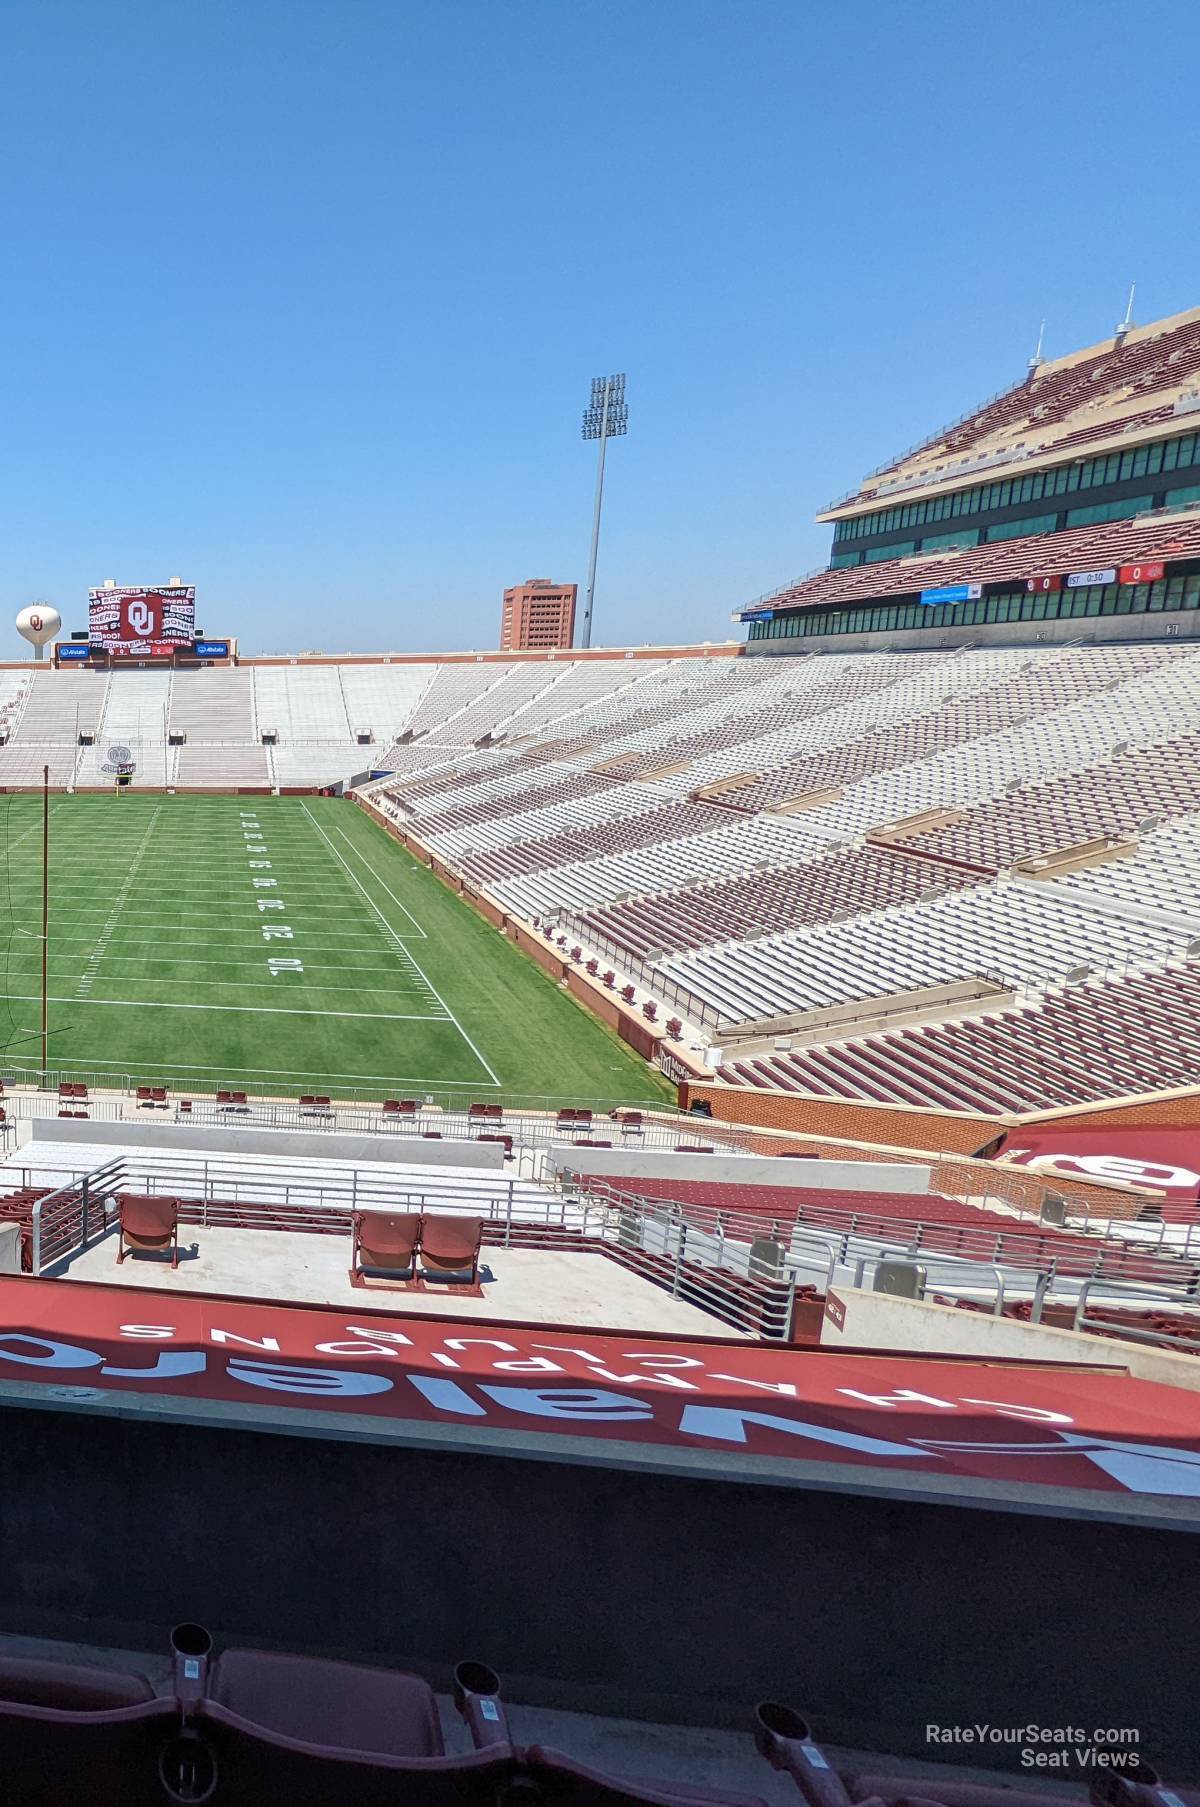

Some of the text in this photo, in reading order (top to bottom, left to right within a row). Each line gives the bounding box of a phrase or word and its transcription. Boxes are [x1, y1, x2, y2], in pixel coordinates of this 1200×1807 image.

[1086, 572, 1104, 583] 0:30
[30, 614, 43, 631] OU
[128, 601, 154, 636] OU
[68, 648, 86, 656] Allstate
[256, 899, 285, 909] 30
[261, 925, 294, 938] 20
[267, 957, 304, 972] 10
[344, 1325, 706, 1368] CLUB
[118, 1323, 1074, 1424] CHAMPIONS
